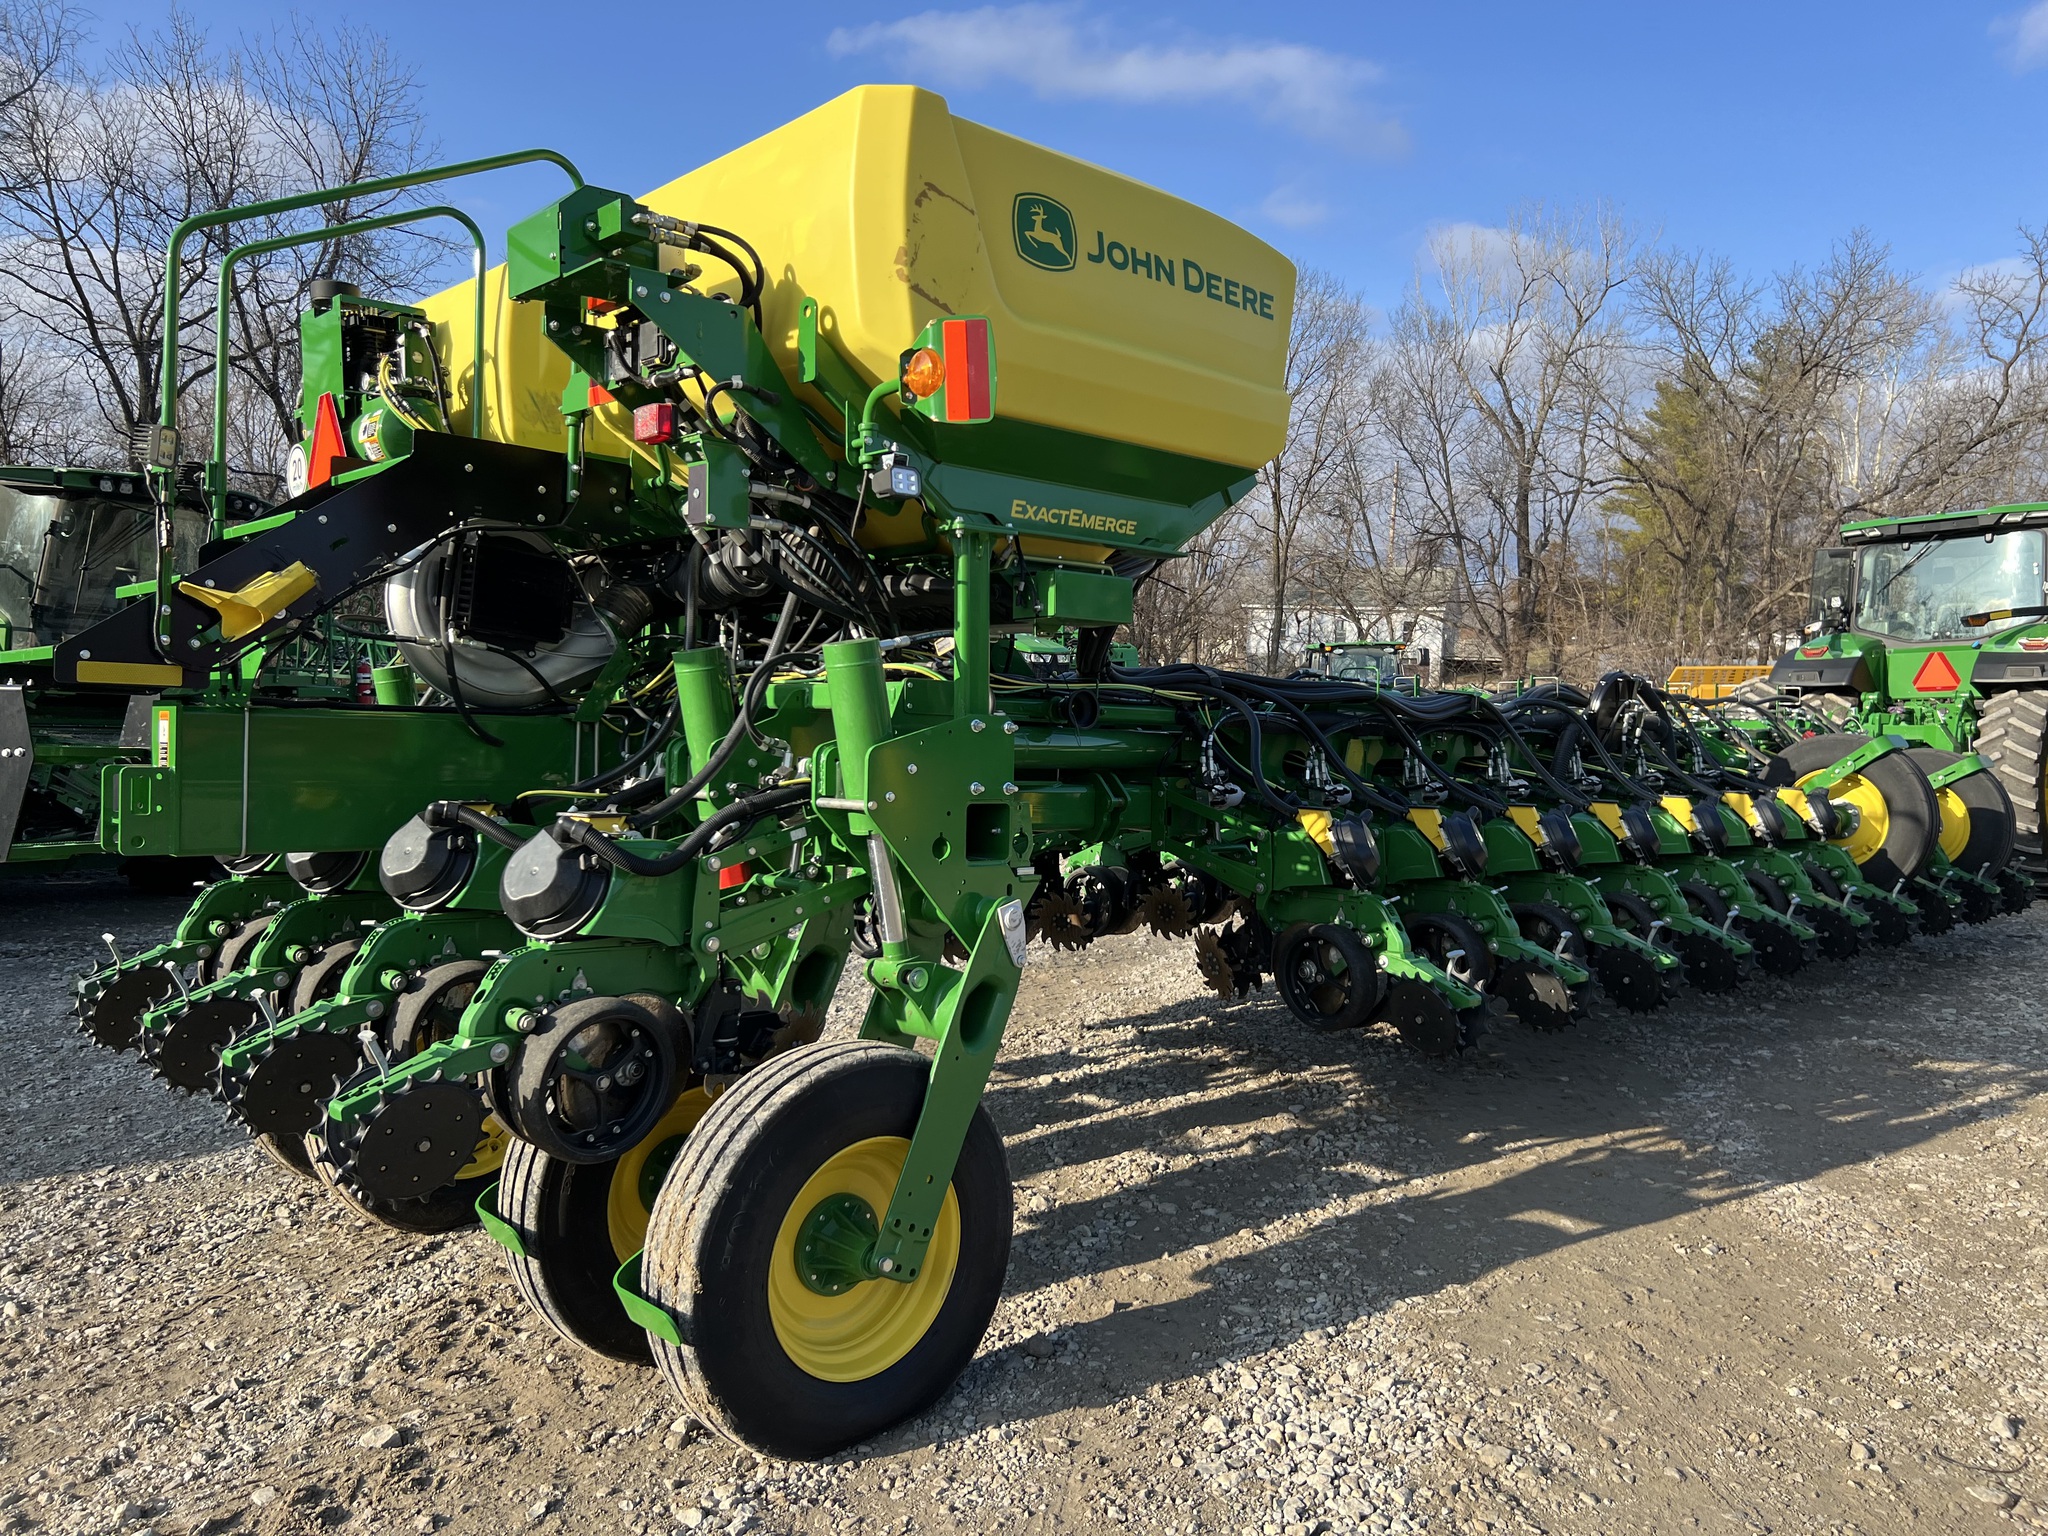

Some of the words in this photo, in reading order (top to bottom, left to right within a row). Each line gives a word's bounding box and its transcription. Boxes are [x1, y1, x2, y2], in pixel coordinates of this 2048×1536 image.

[1087, 231, 1175, 286] JOHN
[1182, 259, 1274, 320] DEERE
[292, 458, 303, 481] 20
